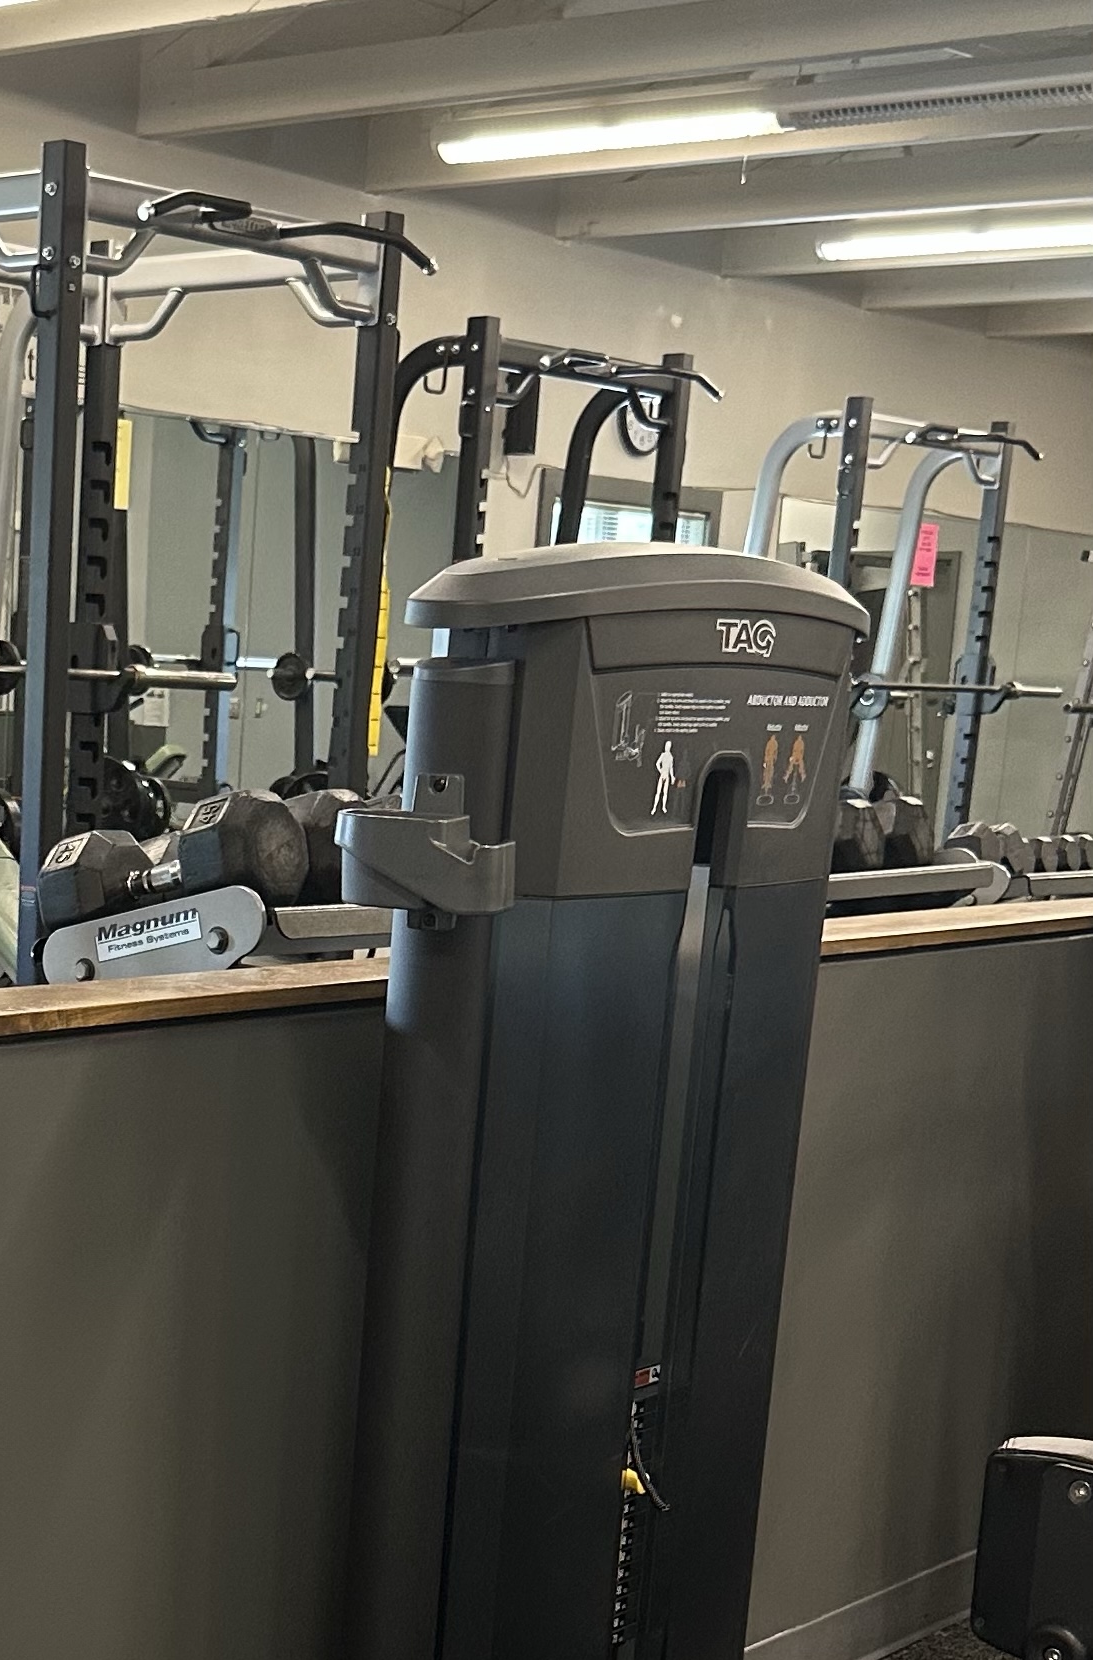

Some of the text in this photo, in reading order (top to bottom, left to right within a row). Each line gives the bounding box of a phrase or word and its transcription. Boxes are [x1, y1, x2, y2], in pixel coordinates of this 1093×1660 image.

[717, 618, 776, 657] TAG
[97, 908, 198, 942] Magnum
[108, 928, 189, 953] Fitness Systems
